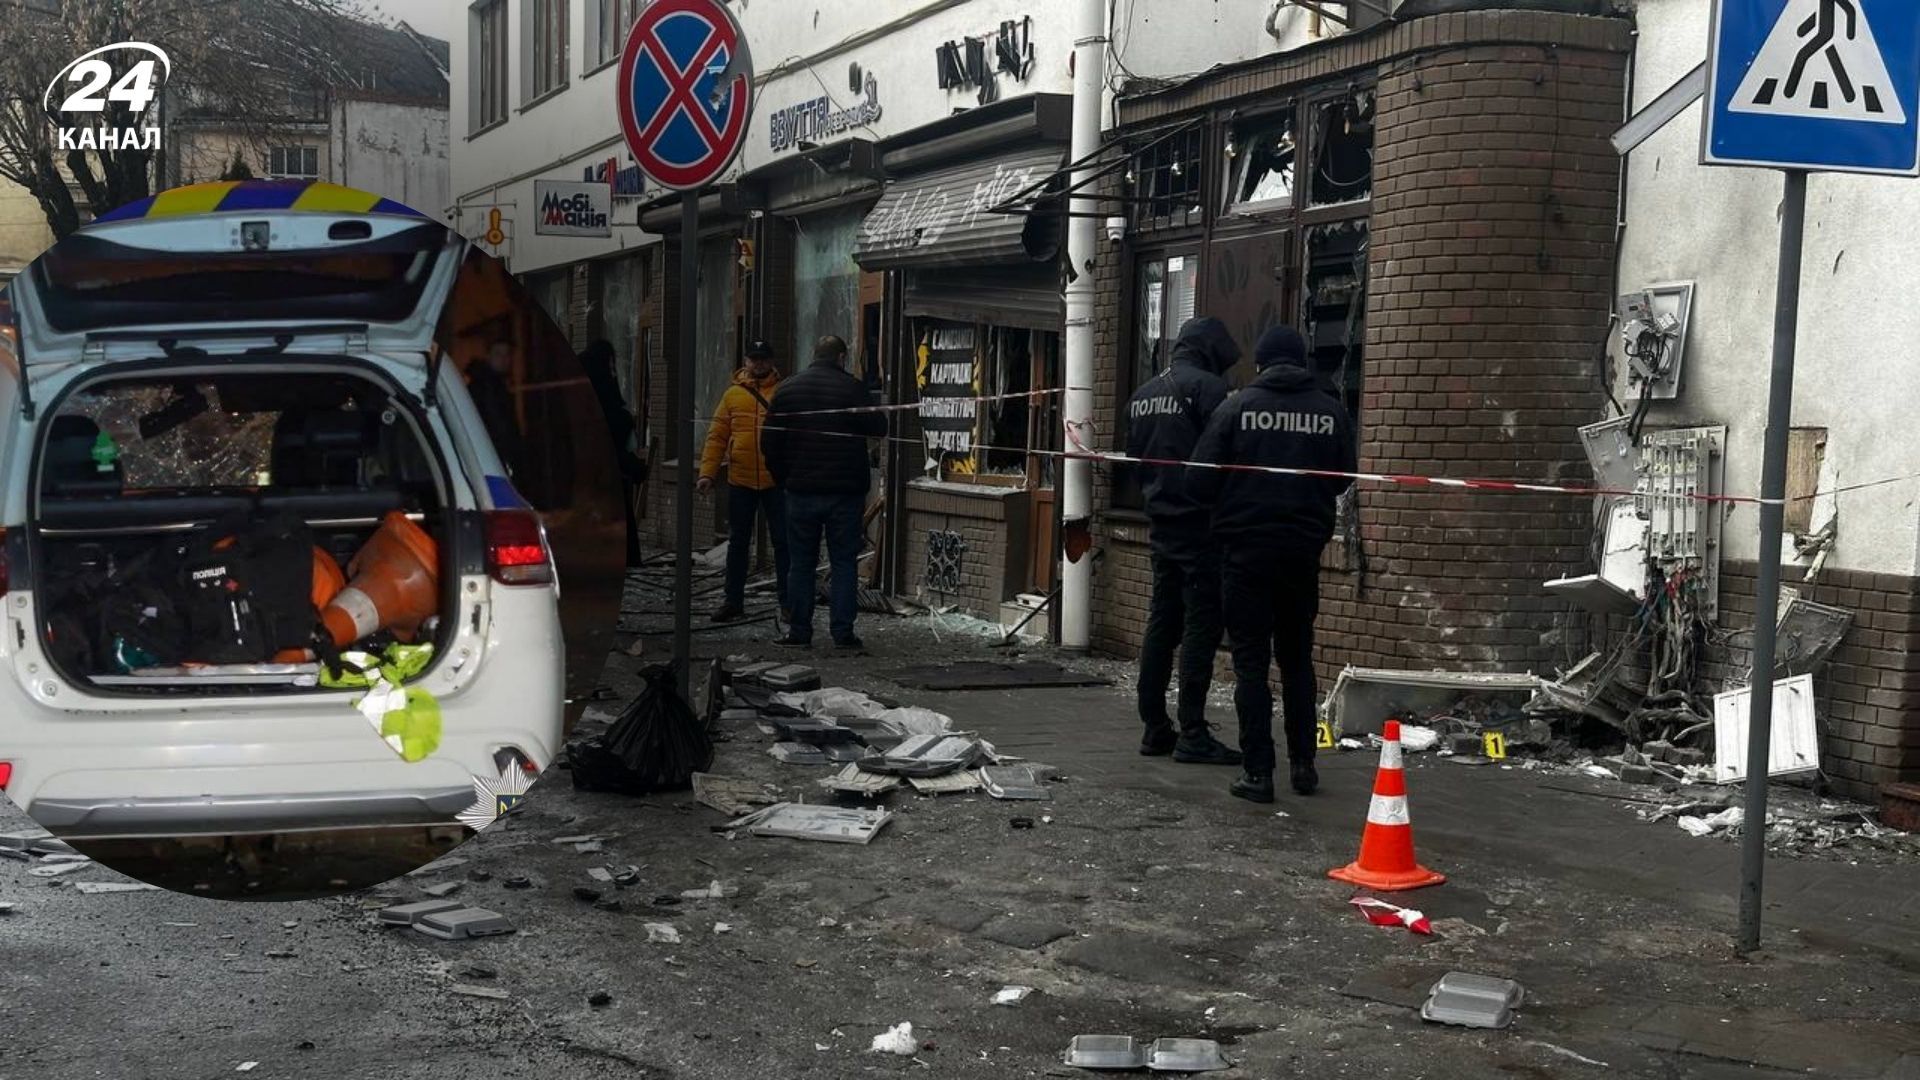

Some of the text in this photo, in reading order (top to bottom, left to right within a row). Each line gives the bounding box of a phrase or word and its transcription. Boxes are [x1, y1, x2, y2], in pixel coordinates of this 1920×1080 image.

[541, 190, 590, 213] Мобі
[544, 207, 607, 228] Манія
[1130, 396, 1193, 419] ПОЛІЦІ
[1241, 411, 1335, 436] ПОЛІЦІЯ
[1316, 727, 1328, 744] 2
[1491, 737, 1500, 754] 1
